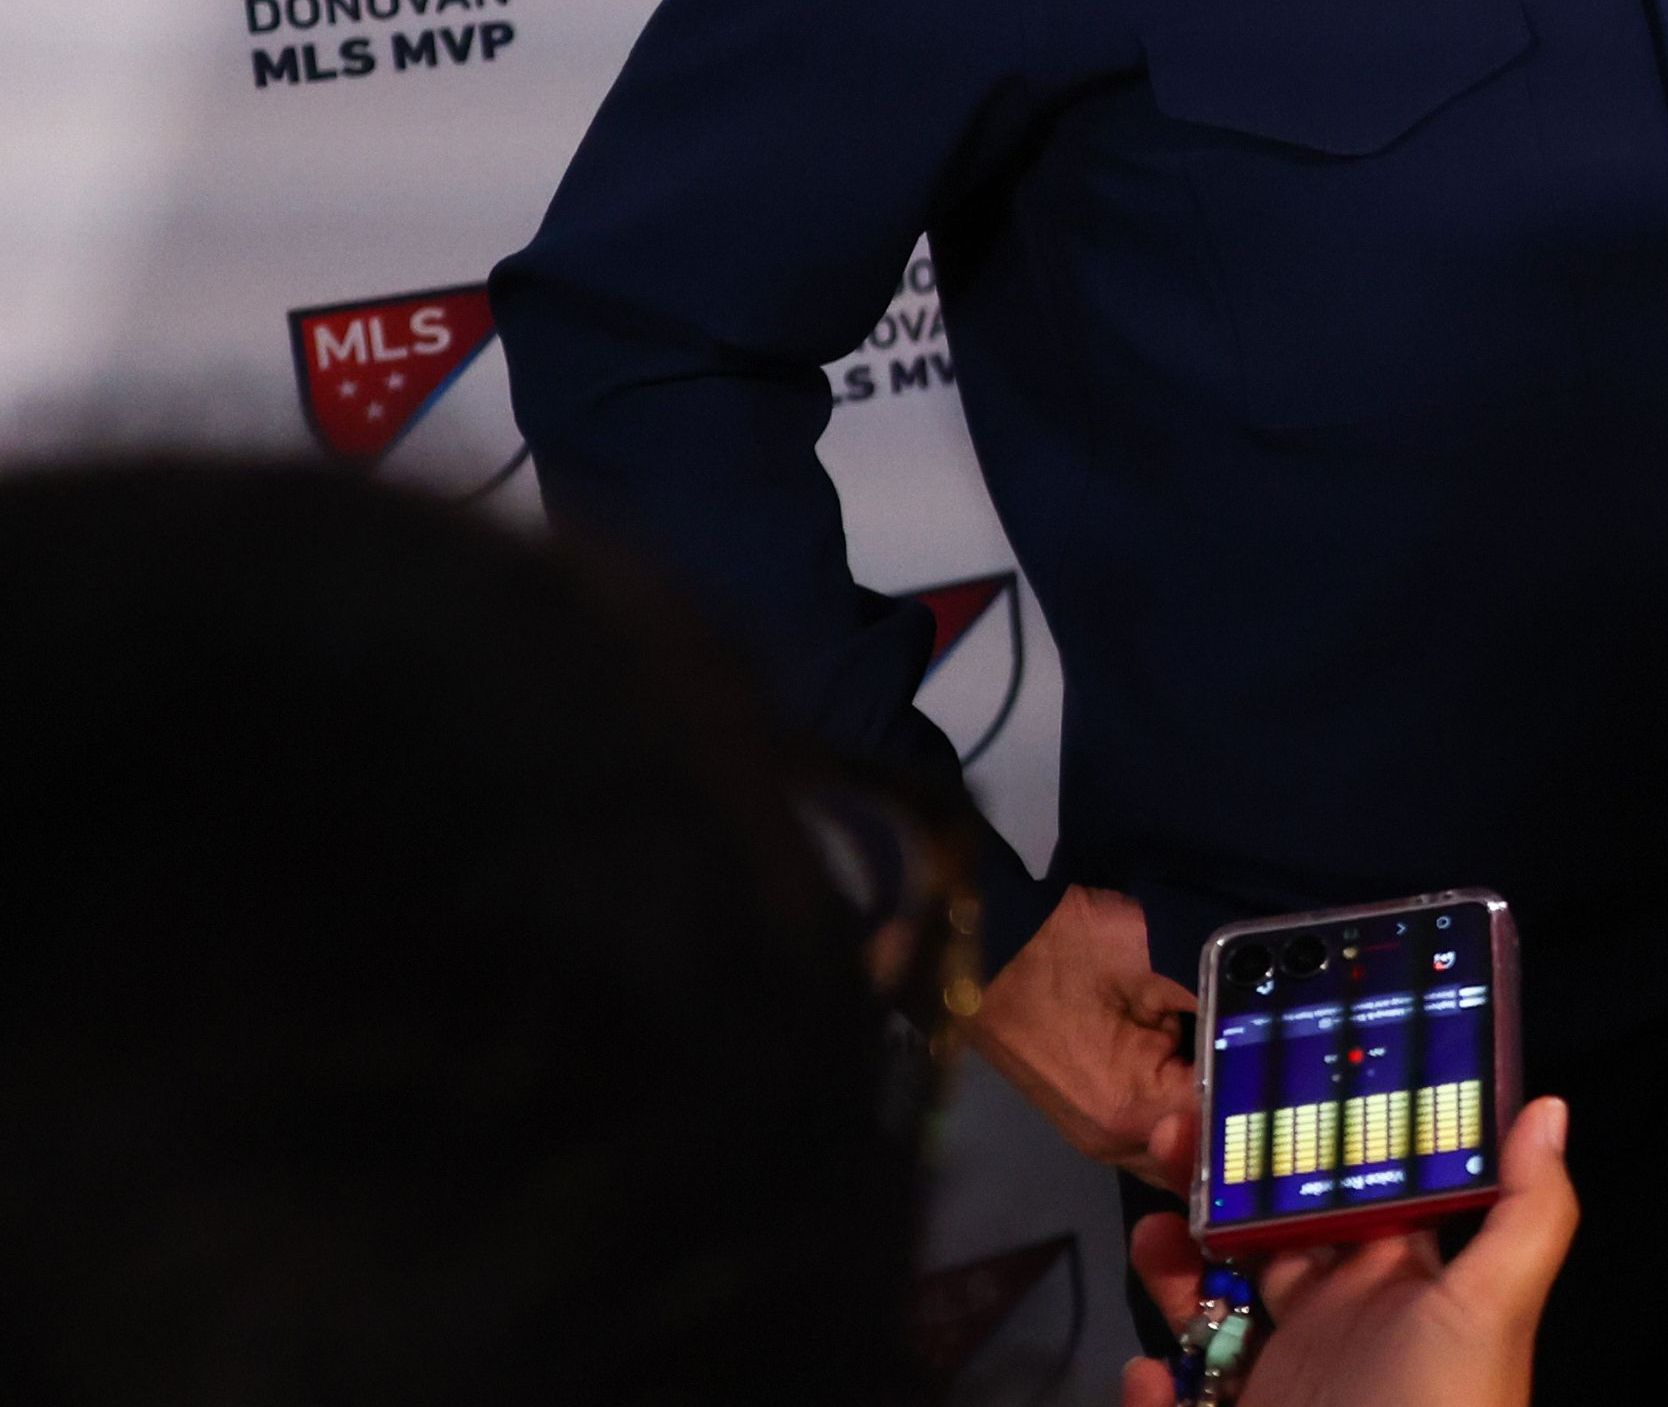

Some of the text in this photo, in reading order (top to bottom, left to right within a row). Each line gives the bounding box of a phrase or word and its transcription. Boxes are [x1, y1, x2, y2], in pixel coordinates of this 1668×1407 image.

[252, 20, 515, 88] MLS MVP
[313, 306, 452, 371] MLS
